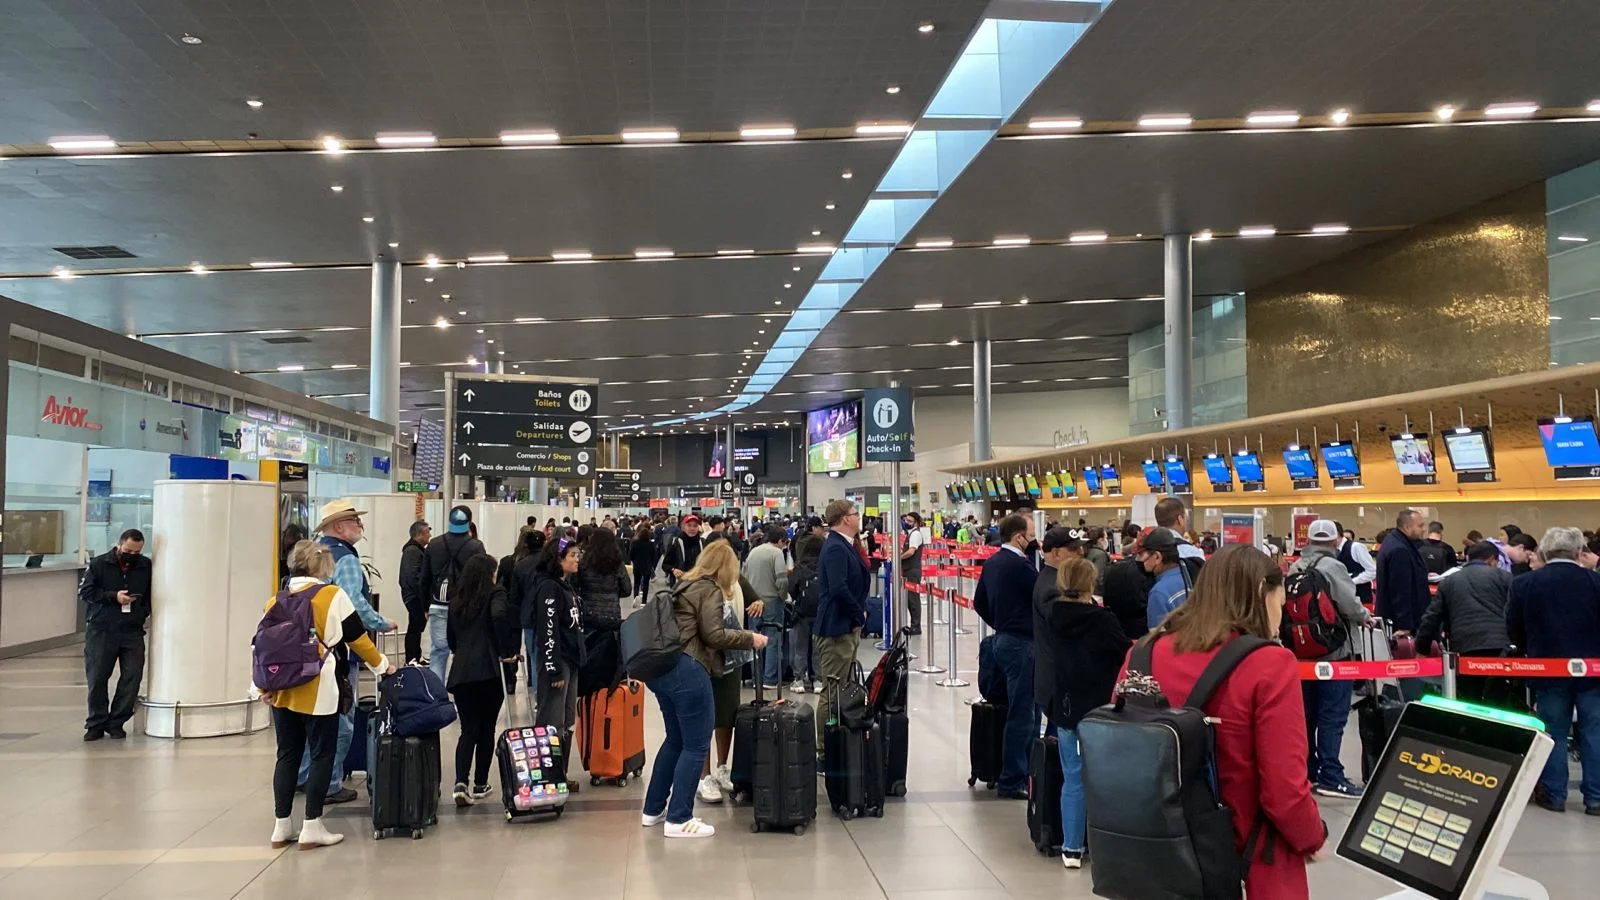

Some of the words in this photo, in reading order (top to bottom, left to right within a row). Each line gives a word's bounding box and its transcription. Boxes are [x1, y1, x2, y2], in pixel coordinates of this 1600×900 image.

[538, 390, 562, 398] Baños
[535, 399, 561, 407] Toilets
[42, 395, 88, 428] Avior
[533, 422, 564, 430] Salidas
[516, 430, 564, 439] Departures
[866, 431, 909, 442] Auto/Self
[866, 444, 901, 454] Check-in
[516, 452, 546, 460] Comercio
[552, 453, 572, 461] Shops
[504, 464, 531, 472] comidas
[1590, 467, 1600, 476] 47
[1399, 751, 1418, 766] EL
